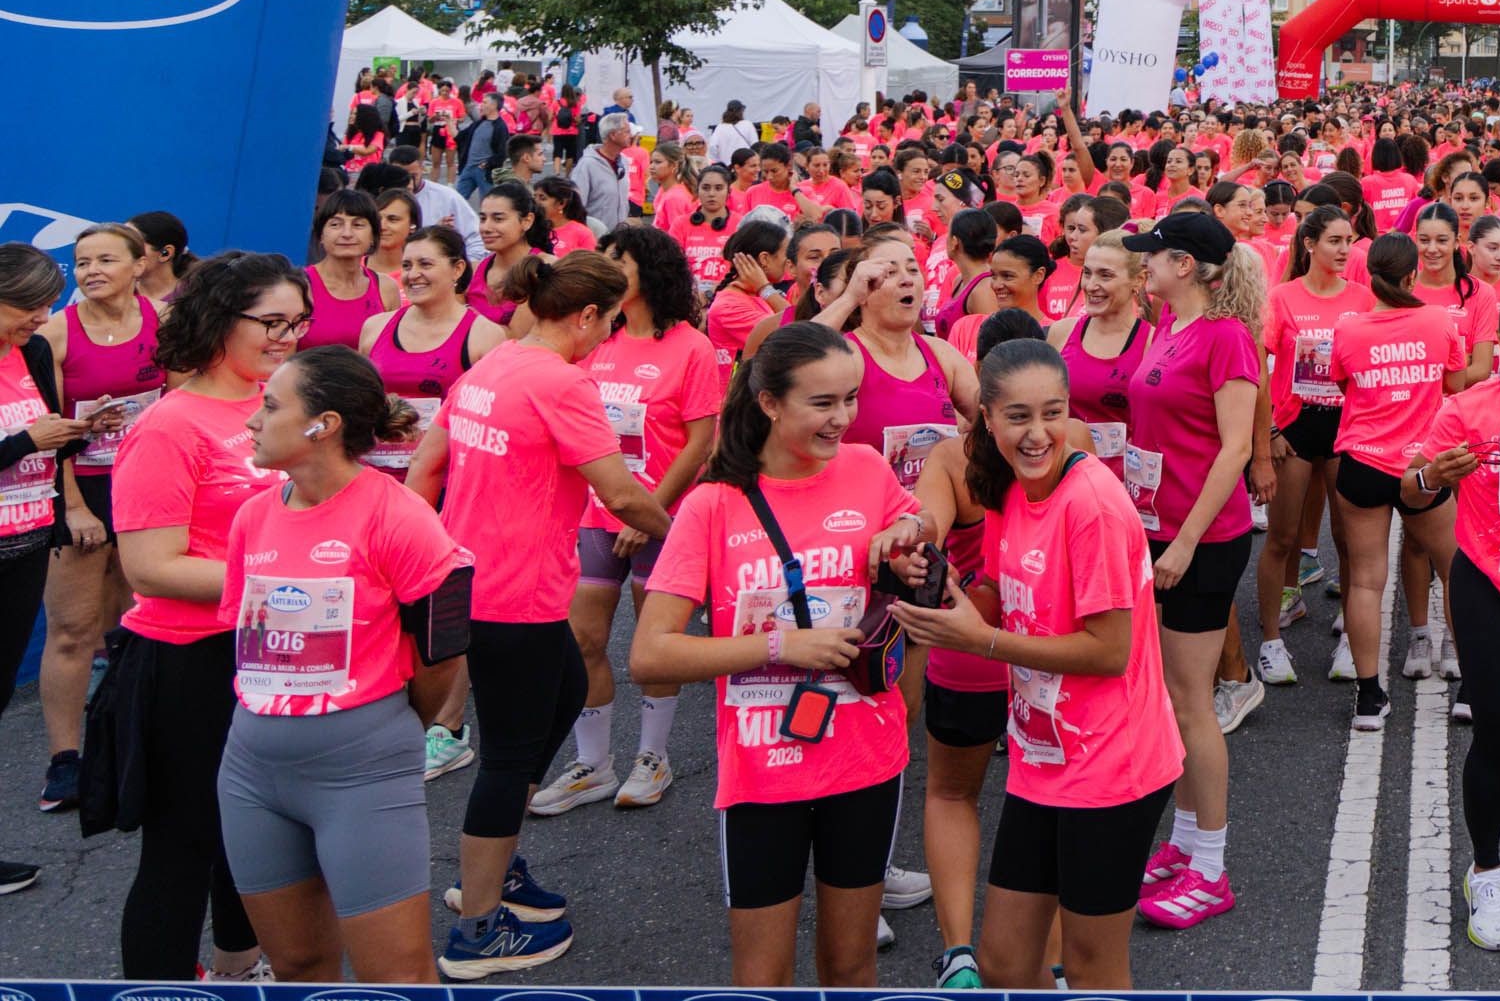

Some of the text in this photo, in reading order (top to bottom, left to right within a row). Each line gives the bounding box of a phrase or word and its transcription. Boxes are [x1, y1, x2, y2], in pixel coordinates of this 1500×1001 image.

[1098, 47, 1158, 68] OYSHO
[1007, 68, 1069, 79] CORREDORAS
[1369, 341, 1427, 365] SOMOS
[1352, 363, 1444, 389] IMPARABLES
[459, 383, 496, 418] SOMOS
[19, 457, 46, 474] 016
[727, 528, 769, 548] OYSH
[269, 595, 311, 609] ASTURIANA
[266, 630, 305, 651] 016
[240, 676, 333, 688] OYSHO Santander
[740, 688, 784, 700] OYSHO
[1013, 694, 1031, 721] 016
[766, 744, 804, 767] 2026
